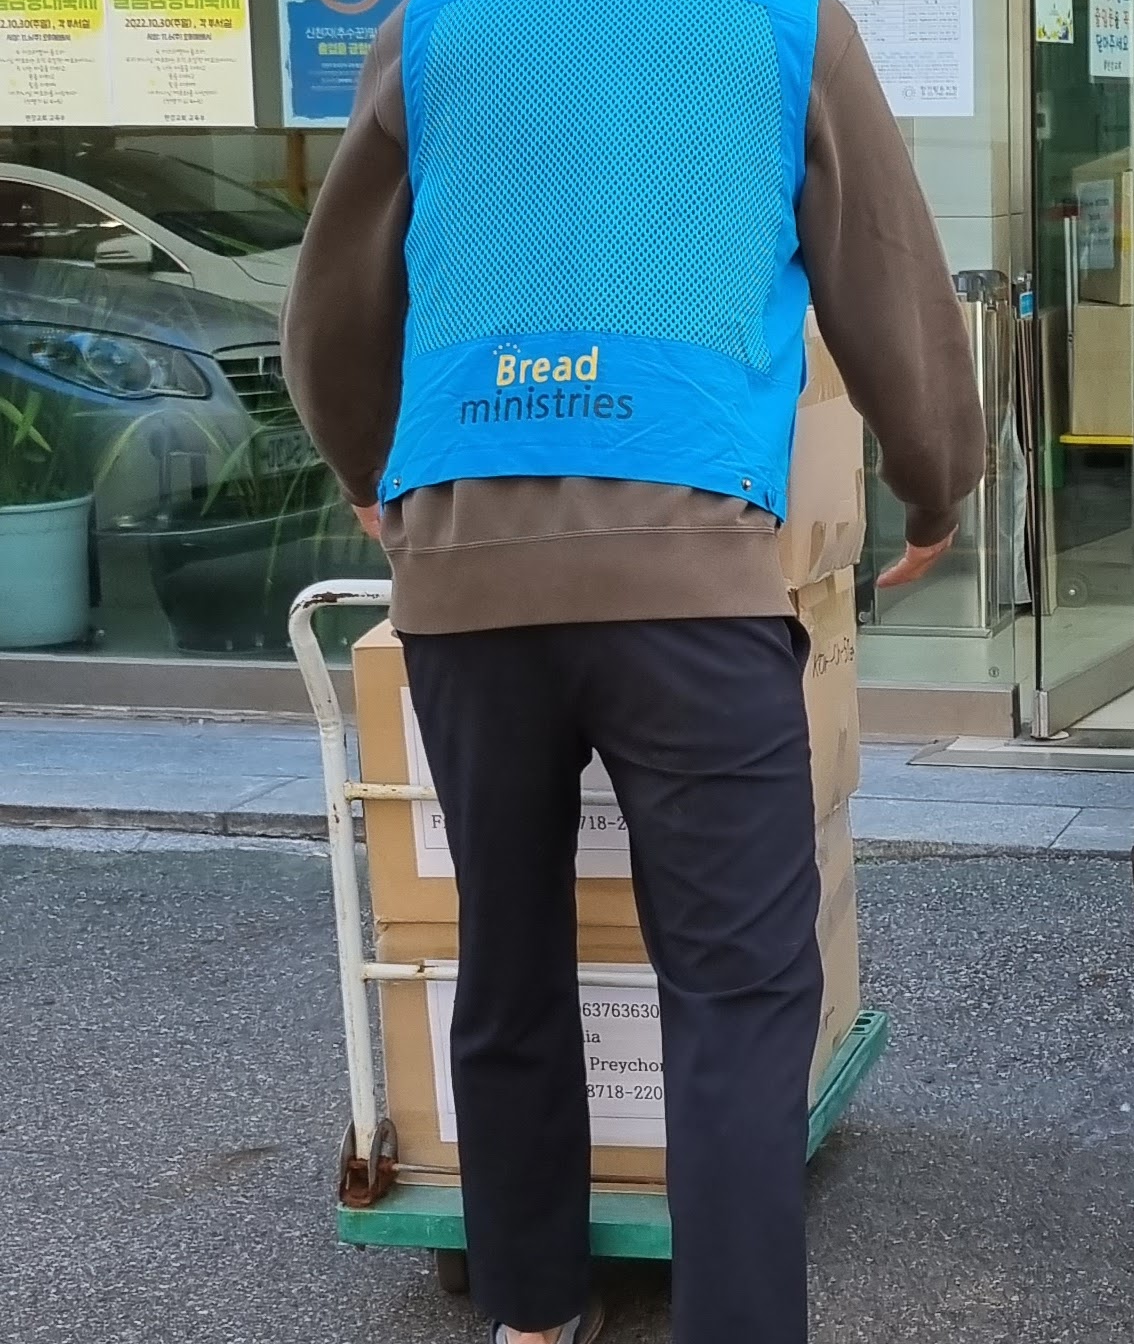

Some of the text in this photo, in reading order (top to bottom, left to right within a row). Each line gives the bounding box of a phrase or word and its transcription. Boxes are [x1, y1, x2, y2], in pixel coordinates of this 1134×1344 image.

[496, 346, 600, 387] Bread
[459, 385, 633, 425] ministries
[582, 1002, 660, 1019] 63763630
[586, 1084, 663, 1101] 8718-220
